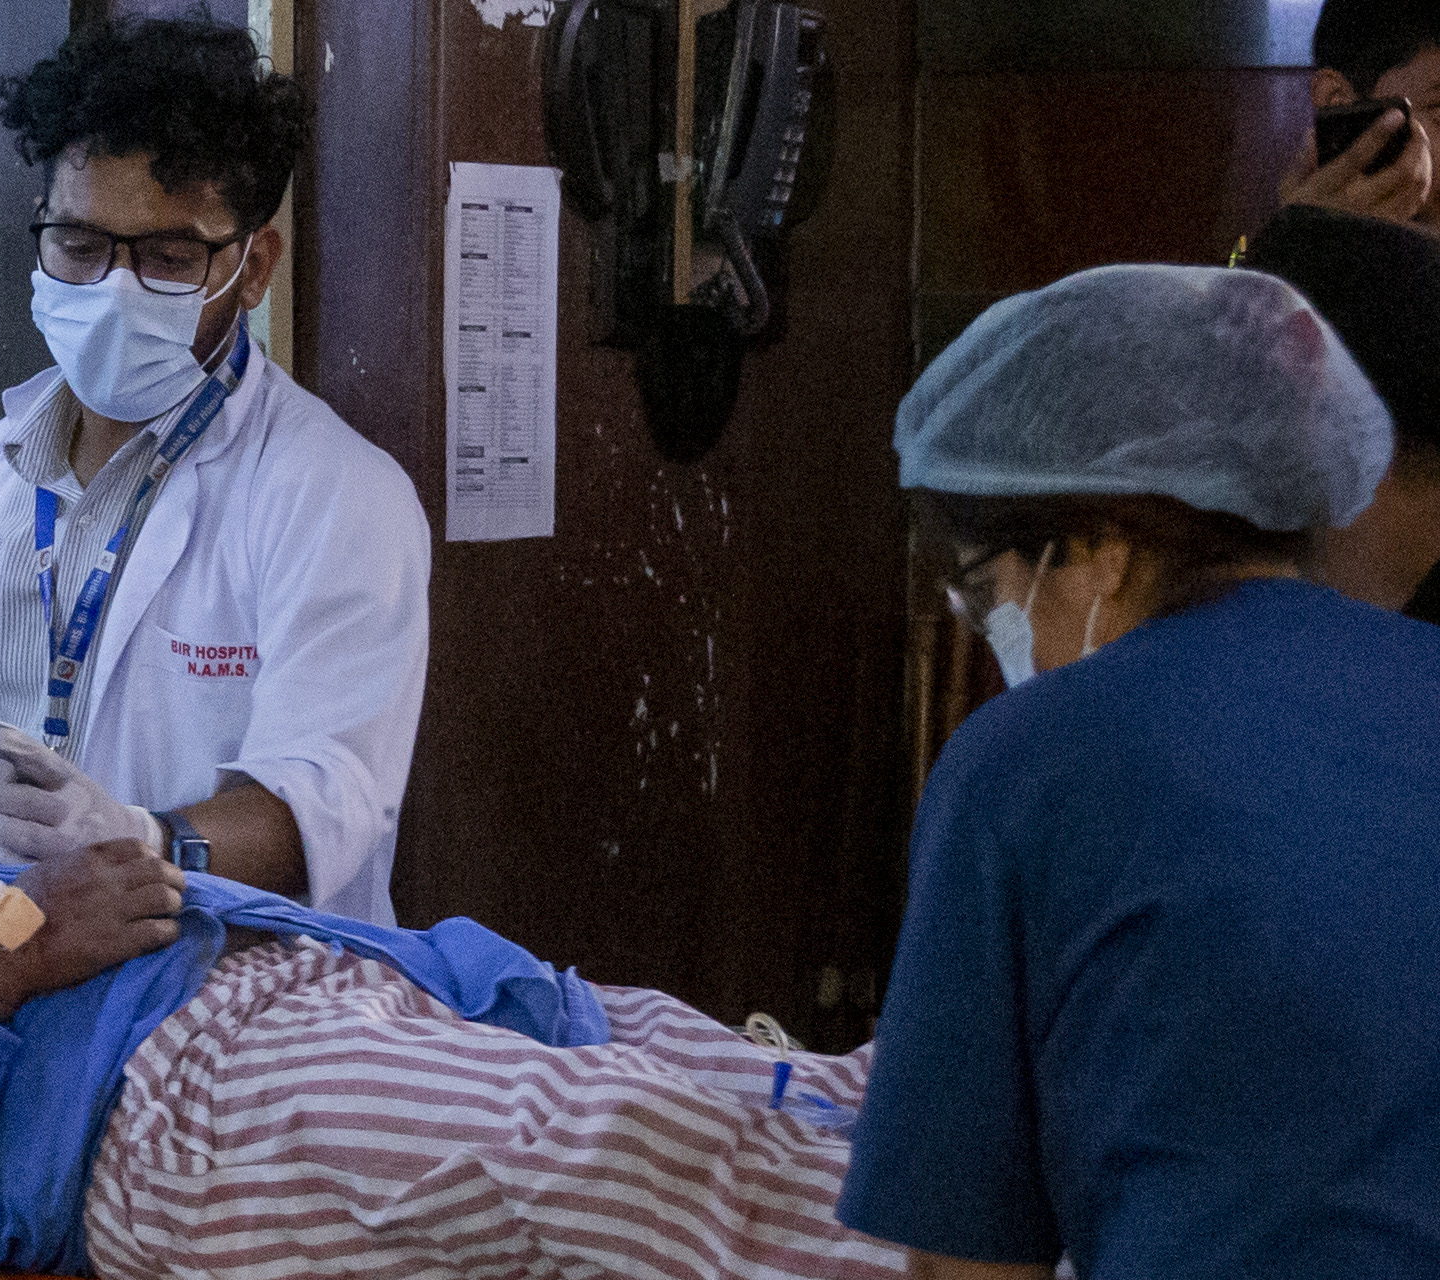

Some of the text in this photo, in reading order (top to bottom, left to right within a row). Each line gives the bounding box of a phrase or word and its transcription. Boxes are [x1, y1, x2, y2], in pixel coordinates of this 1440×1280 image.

[171, 640, 259, 661] BIR HOSPITA
[187, 661, 249, 677] N.A.M.S.
